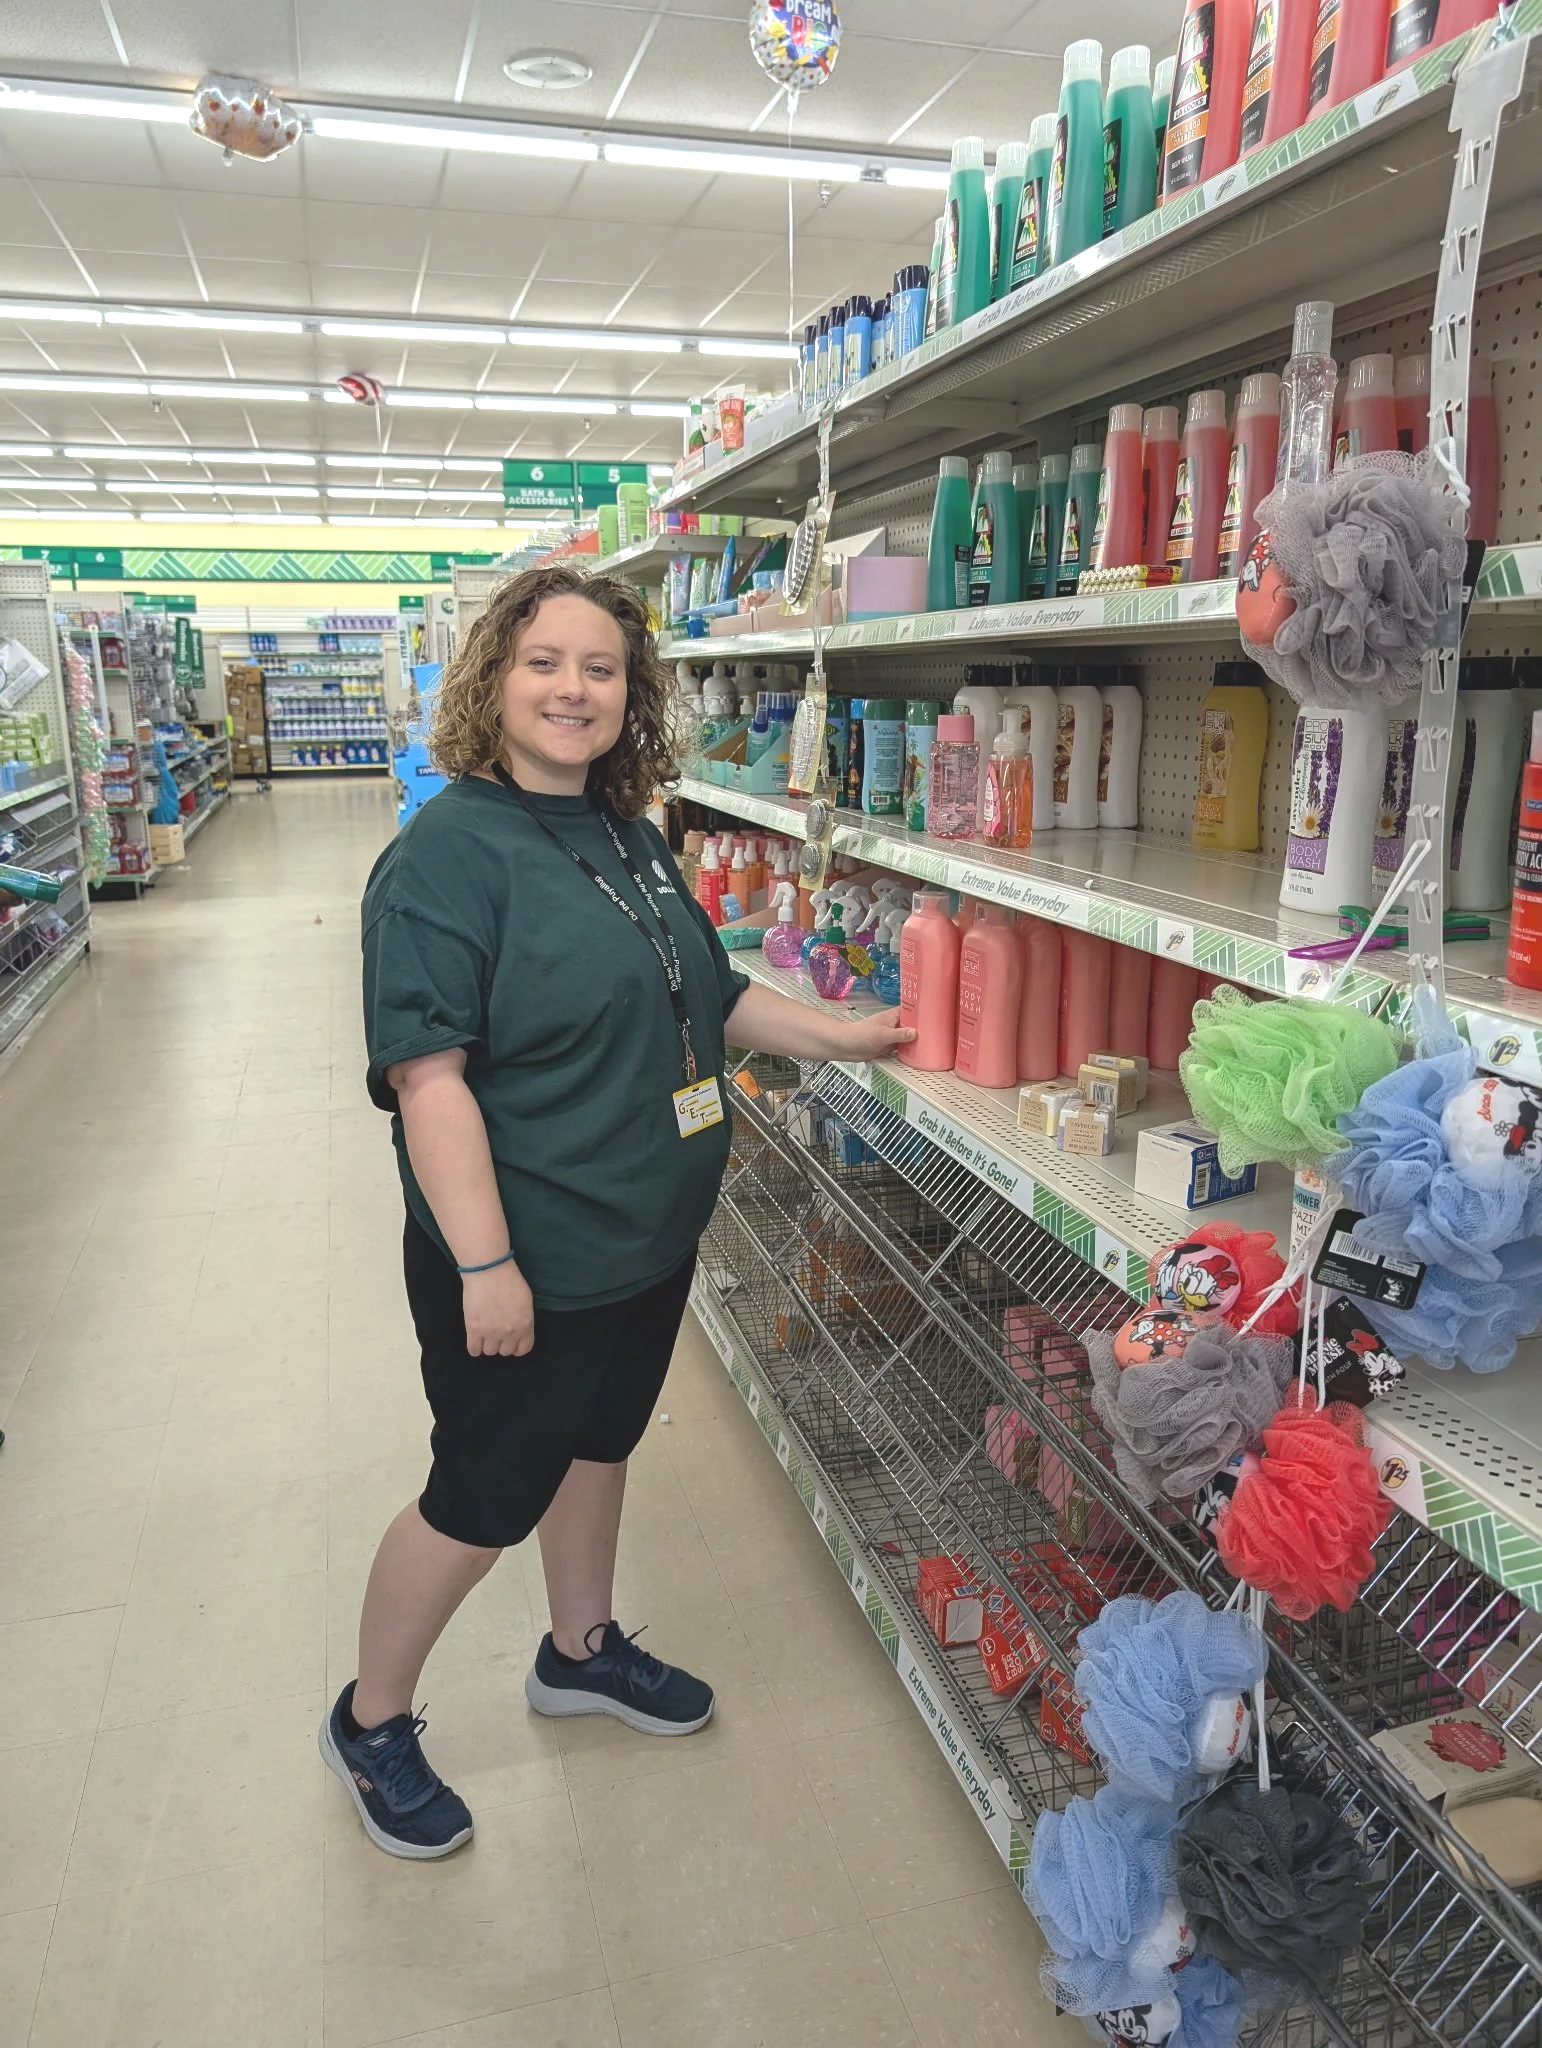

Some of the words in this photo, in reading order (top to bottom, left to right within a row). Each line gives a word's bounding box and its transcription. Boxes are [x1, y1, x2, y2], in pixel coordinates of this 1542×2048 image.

[1182, 96, 1205, 114] LOOKS
[530, 467, 545, 482] 6
[608, 469, 620, 483] 5
[520, 488, 545, 498] BATH
[508, 497, 568, 506] ACCESSORIES
[968, 617, 1004, 631] Extreme
[1006, 611, 1033, 627] Value
[1032, 605, 1084, 628] Everyday
[1206, 722, 1225, 730] SILK
[1305, 733, 1327, 744] SILK
[611, 831, 629, 859] Puyallup
[1290, 843, 1322, 859] BODY
[1289, 855, 1321, 870] WASH
[1373, 857, 1398, 869] ASH
[594, 875, 619, 903] Puyallup
[632, 872, 642, 883] Do
[639, 882, 648, 894] the
[646, 893, 662, 919] Puyallup
[960, 870, 996, 893] Extreme
[996, 878, 1022, 900] Value
[1021, 887, 1070, 918] Everyday
[618, 899, 630, 913] the
[627, 910, 638, 922] Do
[666, 966, 676, 980] the
[670, 978, 678, 992] Do
[903, 990, 918, 1000] ASH
[918, 1110, 939, 1134] Grab
[937, 1124, 946, 1140] It
[944, 1129, 973, 1160] Before
[972, 1150, 987, 1171] It's
[986, 1161, 1019, 1194] Gone!
[1337, 1300, 1350, 1312] 3+
[1008, 1653, 1018, 1679] BAR
[908, 1666, 937, 1719] Extreme
[936, 1713, 959, 1756] Value
[956, 1750, 997, 1821] Everyday
[1450, 1726, 1490, 1762] STRAWBERRY
[1453, 1736, 1476, 1757] CREAM
